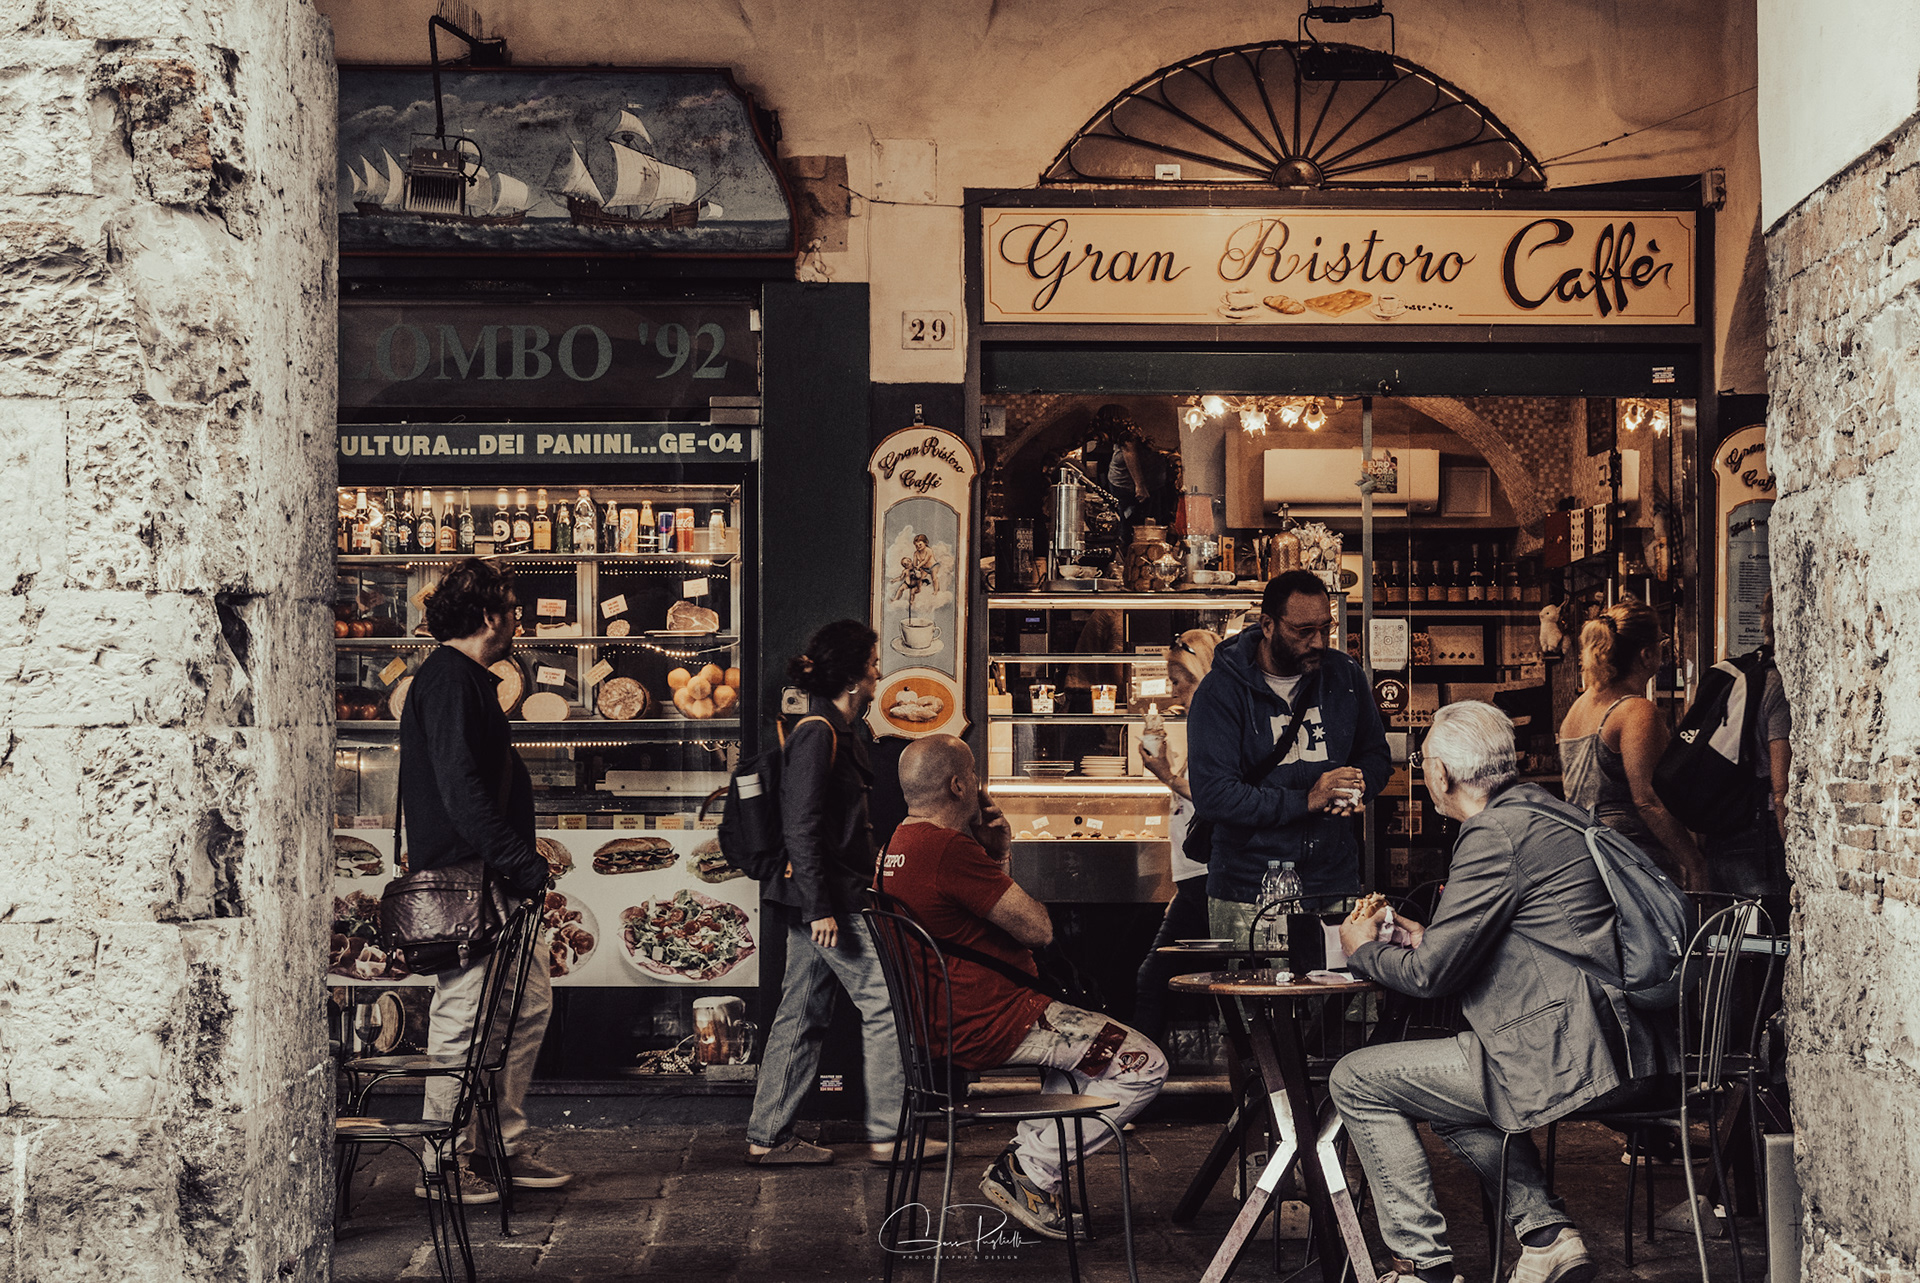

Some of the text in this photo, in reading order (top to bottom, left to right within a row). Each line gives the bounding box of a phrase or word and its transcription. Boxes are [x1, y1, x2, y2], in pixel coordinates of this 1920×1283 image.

[1000, 217, 1673, 318] Gran Ristoro Caffè
[911, 318, 946, 341] 29
[638, 322, 729, 381] '92
[334, 432, 743, 456] ULTURA...DEI PANINI...GE-04
[878, 436, 965, 479] Gran Ristoro
[1726, 442, 1766, 473] Gran
[900, 469, 943, 493] Caffè
[1367, 467, 1395, 475] FLORA
[1376, 474, 1395, 482] 2018
[1742, 470, 1776, 491] Caff
